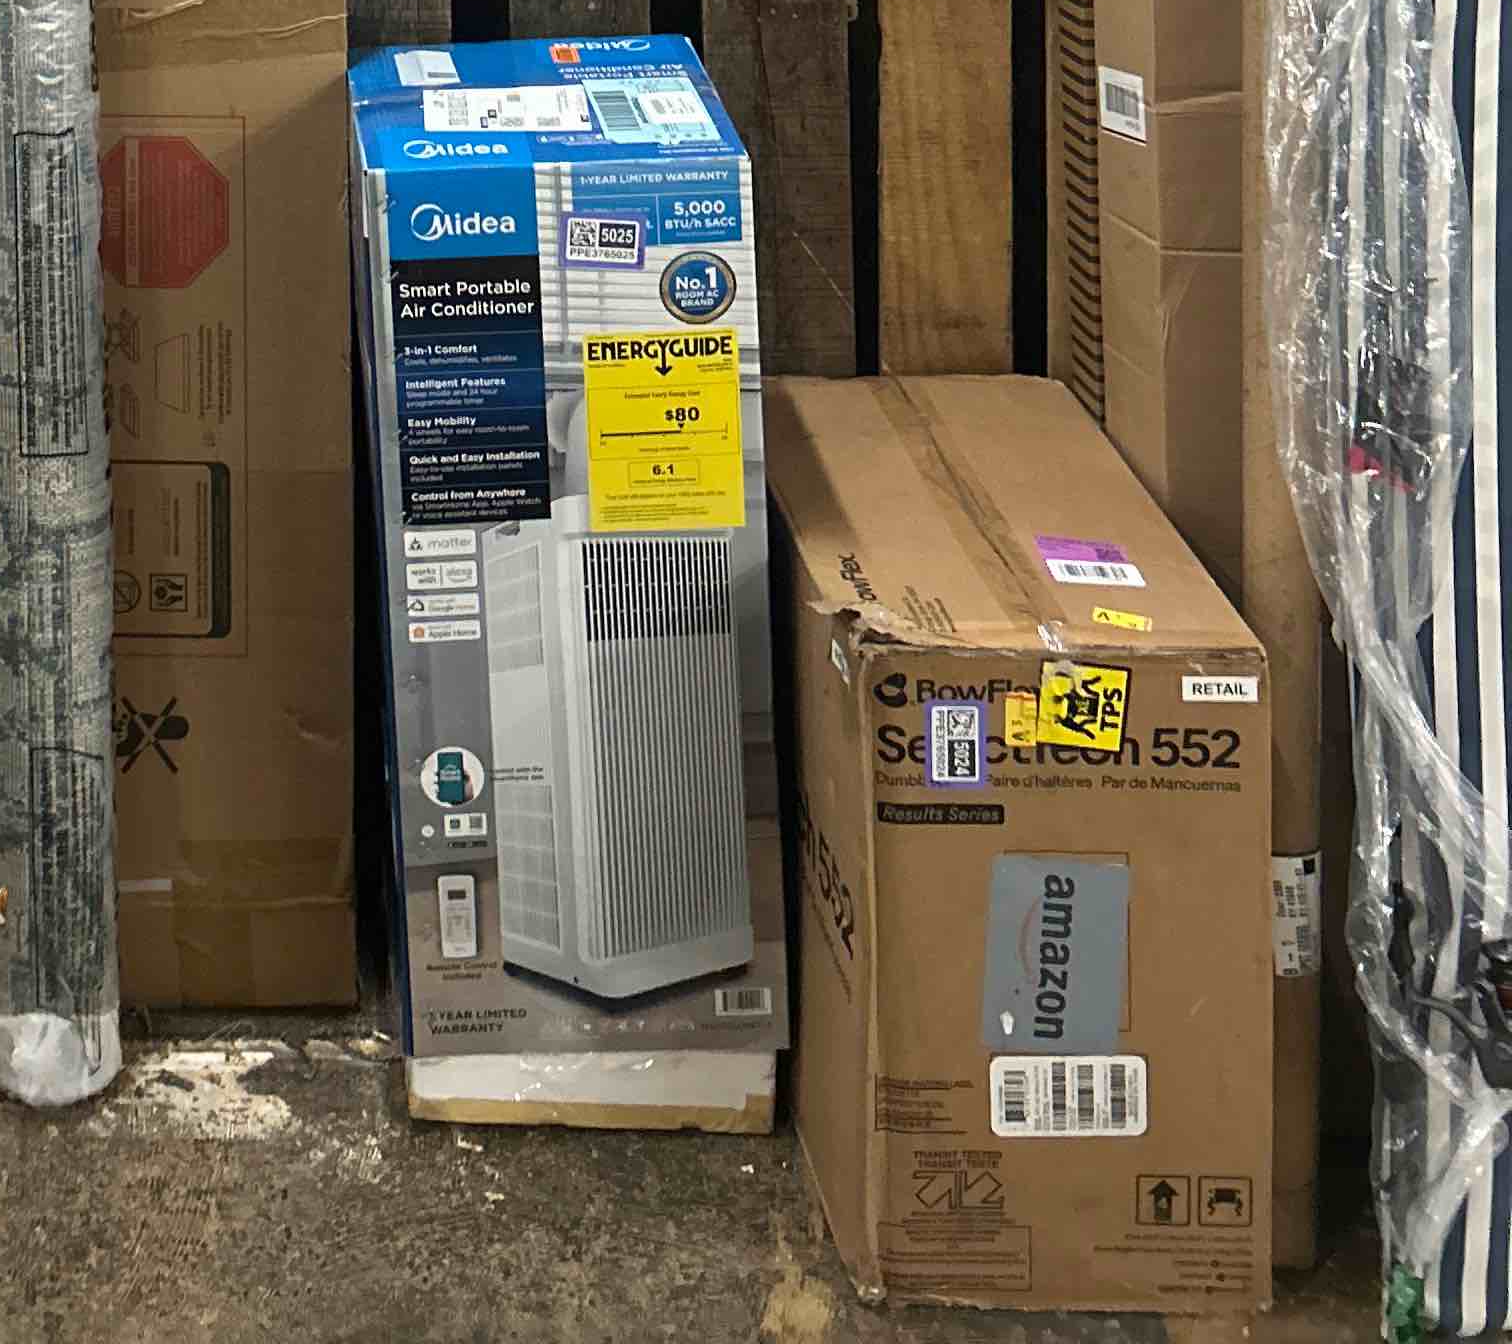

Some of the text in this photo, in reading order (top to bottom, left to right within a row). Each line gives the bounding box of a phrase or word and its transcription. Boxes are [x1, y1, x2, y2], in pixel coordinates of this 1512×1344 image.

[403, 139, 509, 159] Midea
[580, 170, 729, 185] 1-YEAR LIMITED WARRANTY
[673, 199, 726, 218] 5,000
[410, 203, 517, 242] Midea
[664, 216, 737, 230] BTU/h SACC
[600, 228, 634, 244] 5025
[399, 277, 532, 299] Smart Portable
[675, 289, 720, 299] ROOM AC
[400, 298, 536, 320] Air Conditioner
[680, 298, 714, 308] BRAND
[403, 344, 478, 356] 3-in-1 Comfort
[587, 335, 733, 362] ENERGYGUIDE
[405, 377, 506, 391] Intelligent Features
[664, 406, 701, 422] $80
[407, 416, 477, 429] Easy Mobility
[409, 450, 541, 465] Quick and Easy Installation
[652, 463, 675, 475] 6.1
[411, 489, 527, 502] Control from Anywhere
[427, 536, 472, 551] matter
[916, 678, 1040, 703] BowFl
[1191, 682, 1249, 697] RETAIL
[1099, 687, 1124, 733] TPS
[1150, 727, 1241, 769] 552
[952, 741, 972, 775] 5024
[1101, 775, 1127, 789] Par
[1129, 776, 1148, 790] de
[1151, 777, 1241, 793] Mancuernas
[882, 805, 1001, 823] Results Series
[1030, 874, 1076, 1041] amazon
[476, 1008, 527, 1020] LIMITED
[430, 1022, 504, 1035] WARRANTY
